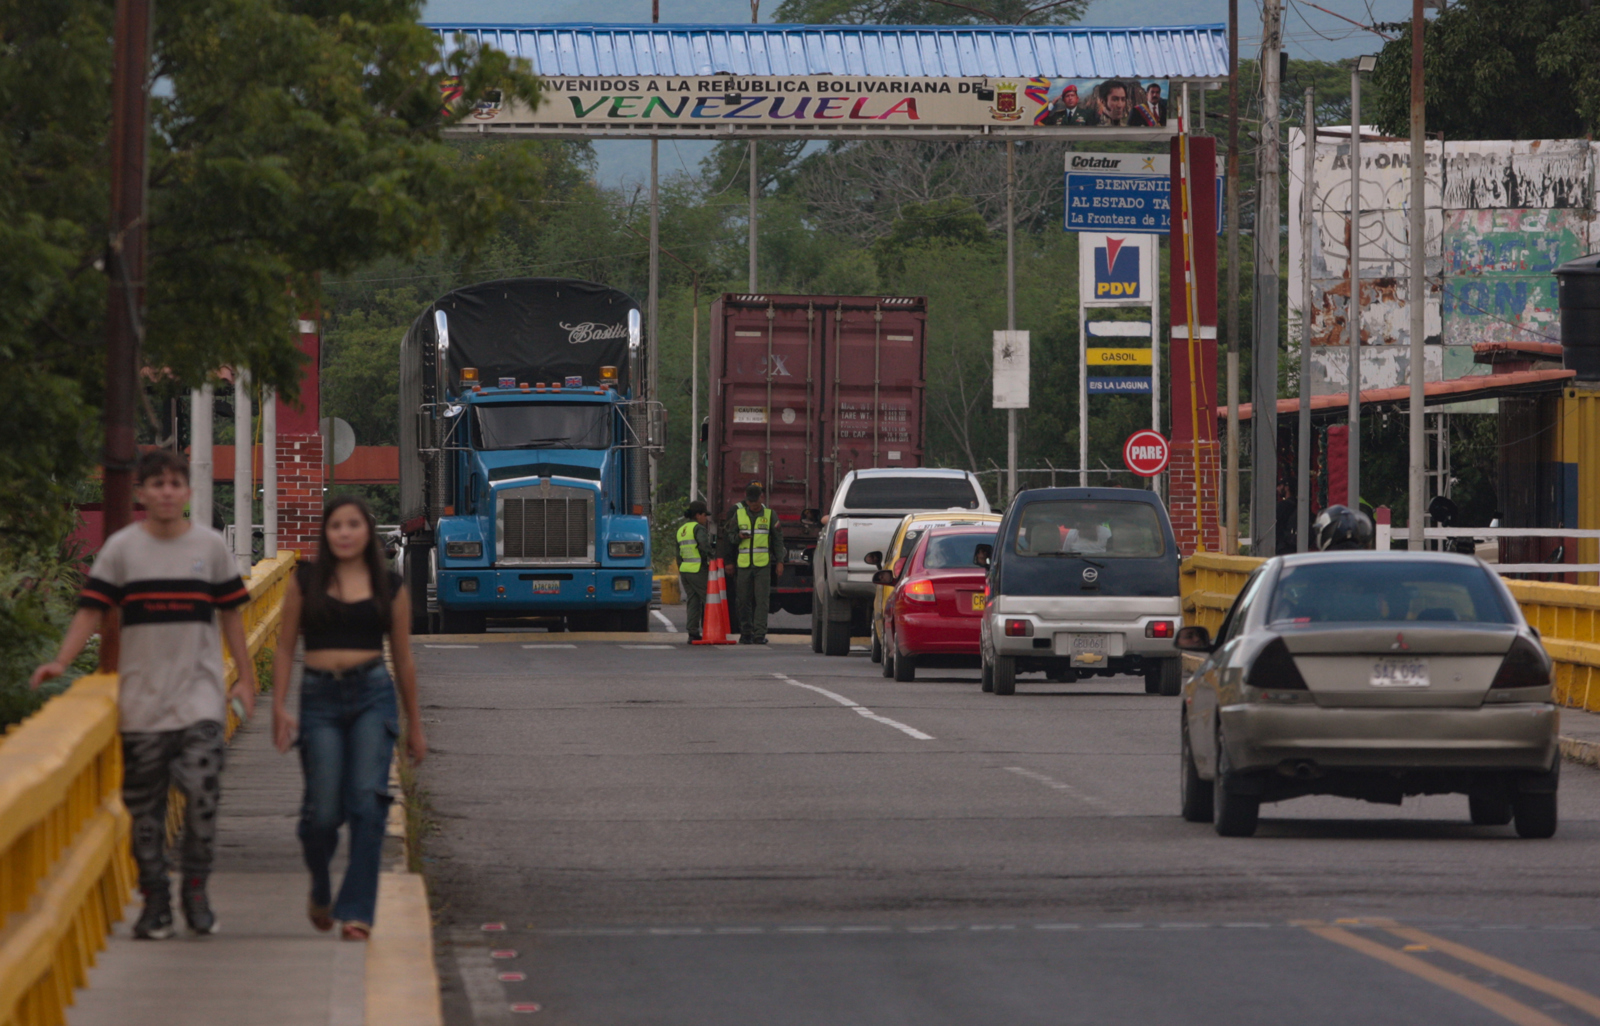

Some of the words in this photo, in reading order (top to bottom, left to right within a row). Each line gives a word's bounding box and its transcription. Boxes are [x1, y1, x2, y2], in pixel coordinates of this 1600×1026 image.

[537, 79, 640, 92] NVENIDOS
[646, 80, 660, 92] A
[666, 80, 691, 92] LA
[697, 77, 810, 93] REPÚBLICA
[816, 80, 952, 93] BOLIVARIANA
[567, 95, 921, 119] VENEZUELA
[1071, 155, 1121, 169] Cotatur
[1071, 196, 1090, 208] AL
[1092, 197, 1145, 209] ESTADO
[1071, 212, 1084, 223] La
[1087, 212, 1137, 225] Frontera
[1142, 214, 1155, 226] de
[1097, 282, 1138, 295] PDV
[1101, 352, 1137, 361] GASOIL
[1089, 381, 1103, 390] E/S
[1103, 381, 1115, 390] LA
[1115, 381, 1150, 390] LAGUNA
[840, 411, 857, 420] TARE
[1131, 445, 1163, 460] PARE
